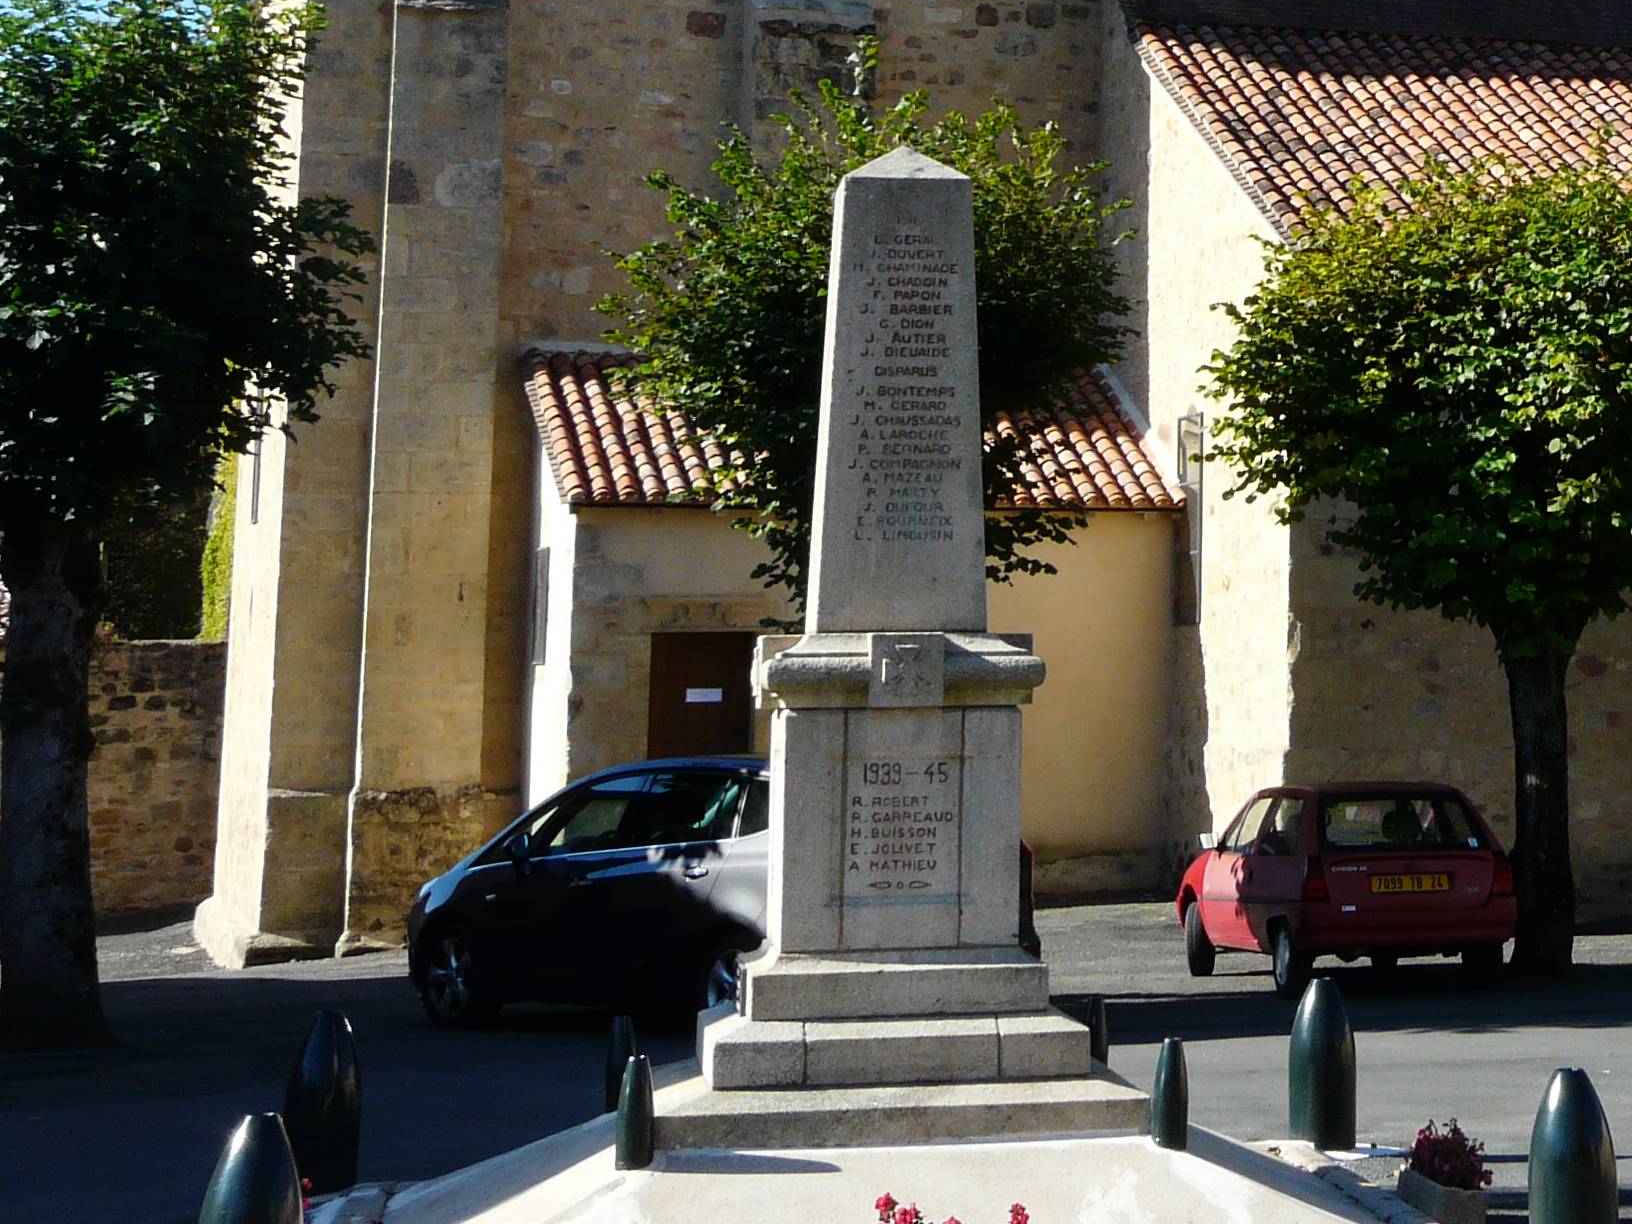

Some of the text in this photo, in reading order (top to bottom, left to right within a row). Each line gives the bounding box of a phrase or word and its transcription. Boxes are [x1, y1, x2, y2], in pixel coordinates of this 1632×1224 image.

[894, 290, 941, 301] PAPON
[889, 304, 952, 316] BARBIER
[900, 318, 934, 329] DION
[891, 332, 947, 344] AUTIER
[875, 366, 938, 377] DISPARUS
[877, 385, 956, 397] BONTEMPS
[871, 795, 929, 807] ROBERT
[851, 827, 936, 839] H. BUISSON
[850, 843, 936, 855] E. JOLIVET
[870, 860, 937, 871] MATHIEU
[1376, 876, 1443, 890] 7099 TB 24
